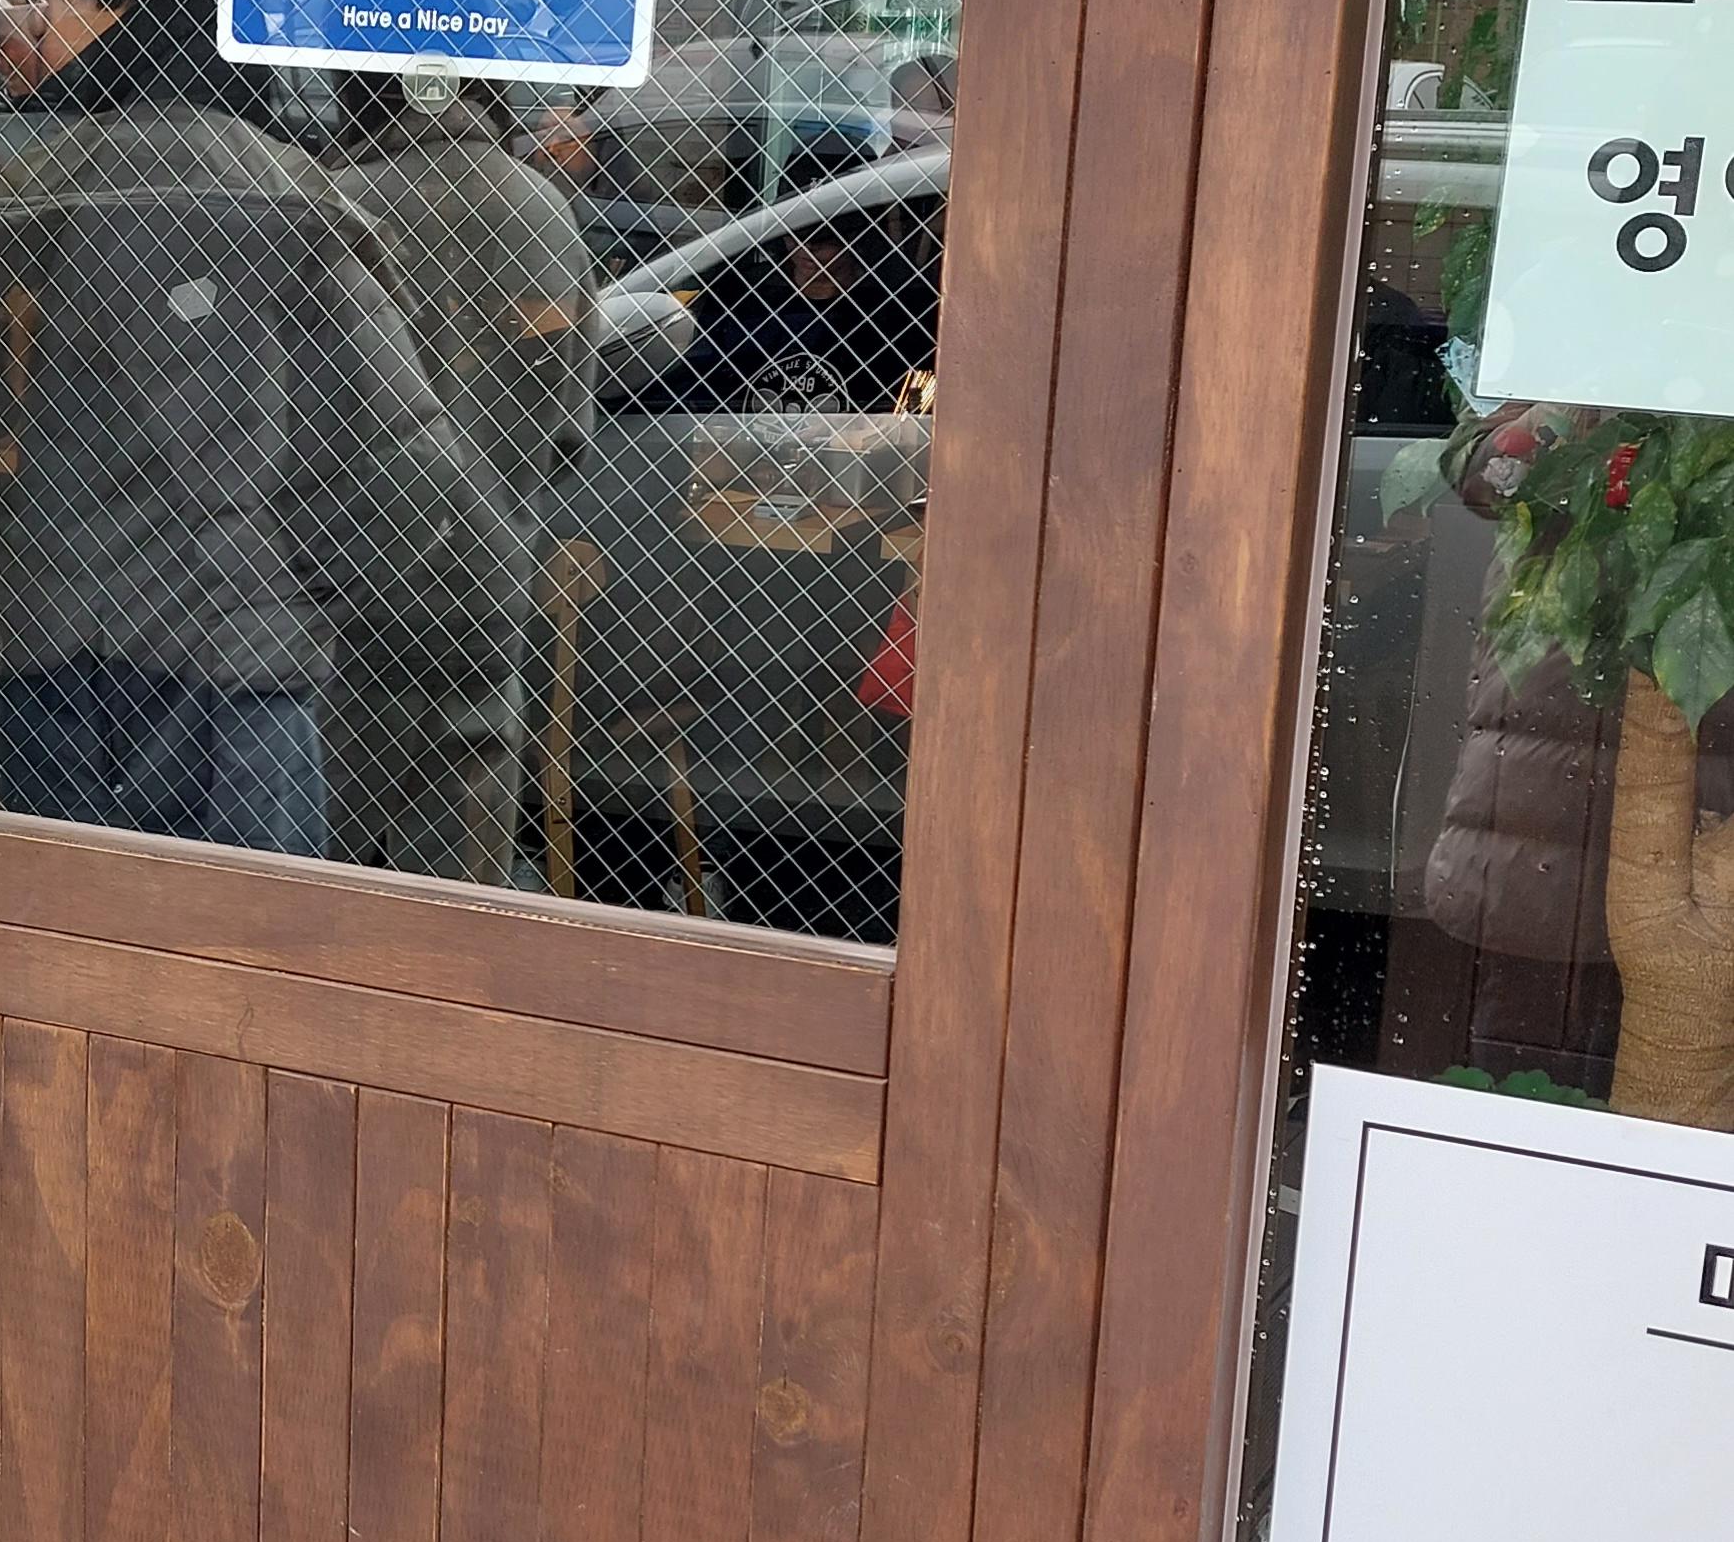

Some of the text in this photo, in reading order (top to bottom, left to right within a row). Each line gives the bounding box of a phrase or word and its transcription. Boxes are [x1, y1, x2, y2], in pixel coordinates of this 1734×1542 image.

[343, 5, 509, 37] Have a Nice Day
